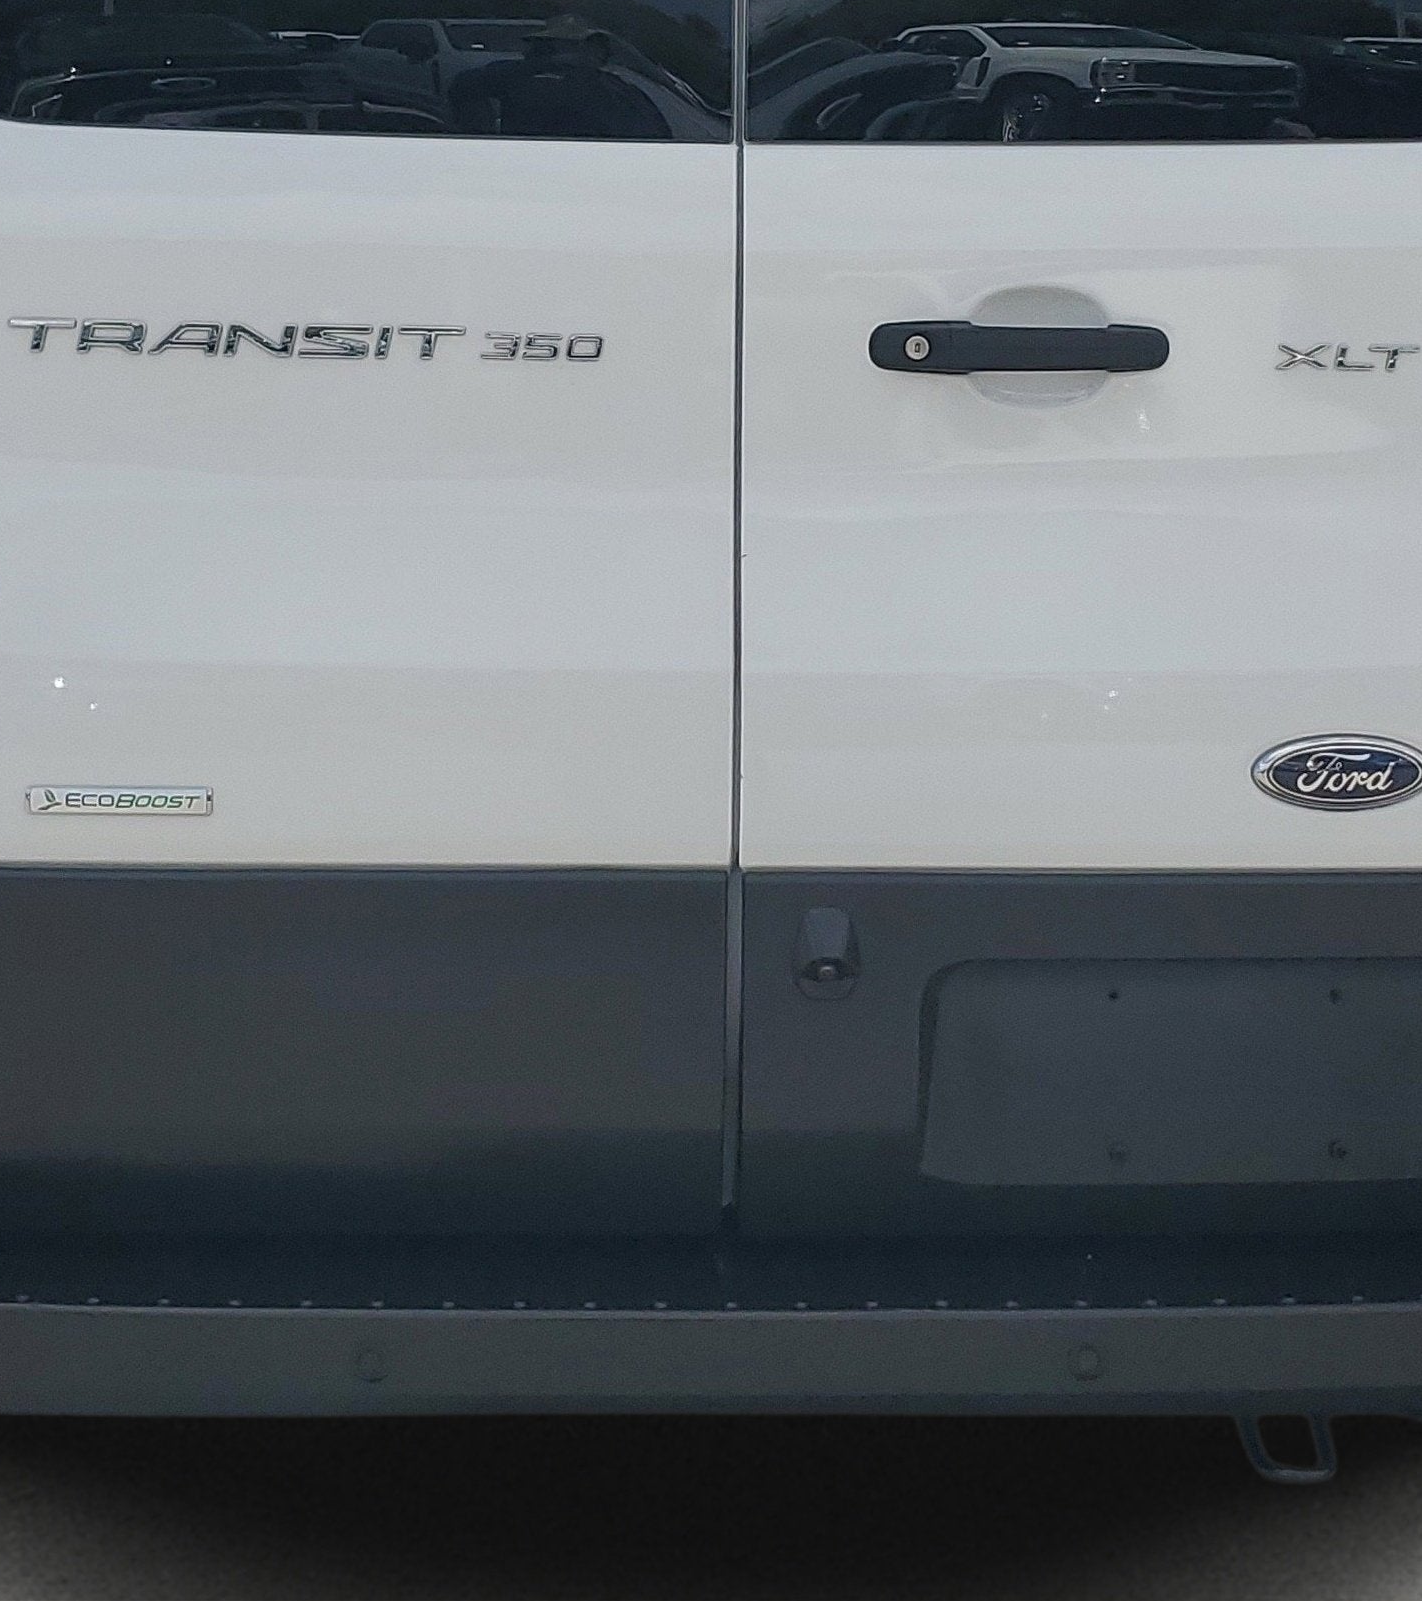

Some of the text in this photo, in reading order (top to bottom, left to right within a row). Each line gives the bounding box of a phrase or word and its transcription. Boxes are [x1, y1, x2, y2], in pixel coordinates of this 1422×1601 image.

[7, 317, 606, 362] TRANSIT 350
[1275, 343, 1421, 373] XLT
[1296, 752, 1395, 793] Ford
[64, 792, 201, 809] ECOBOOST
